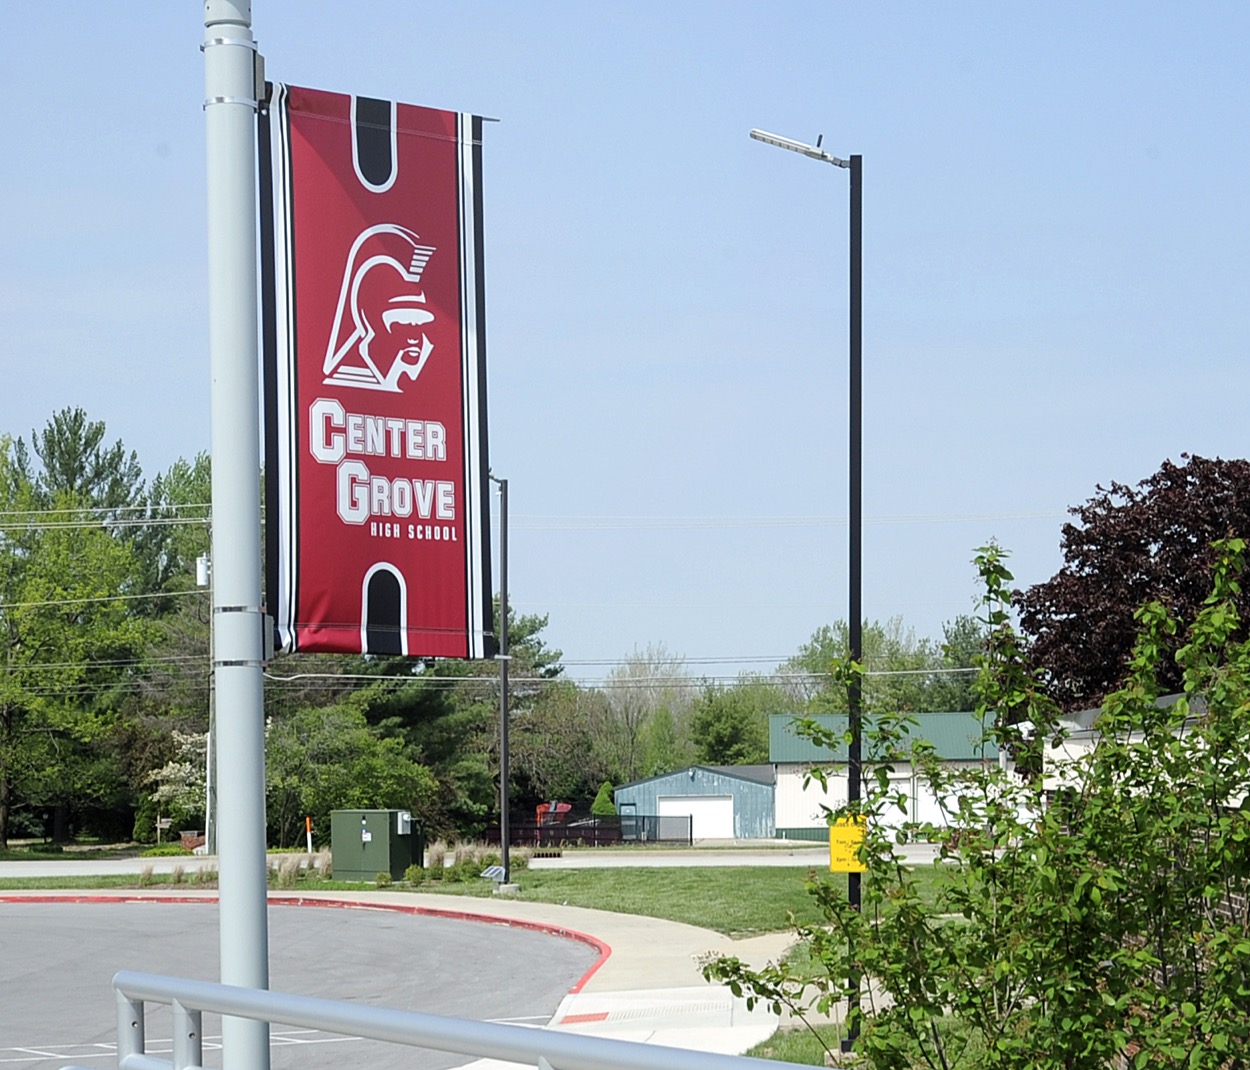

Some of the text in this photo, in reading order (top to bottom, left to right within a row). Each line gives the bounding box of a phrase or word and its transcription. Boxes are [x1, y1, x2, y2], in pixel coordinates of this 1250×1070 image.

[309, 397, 446, 464] CENTER
[336, 458, 455, 525] GROVE
[370, 522, 457, 541] HIGH SCHOOL
